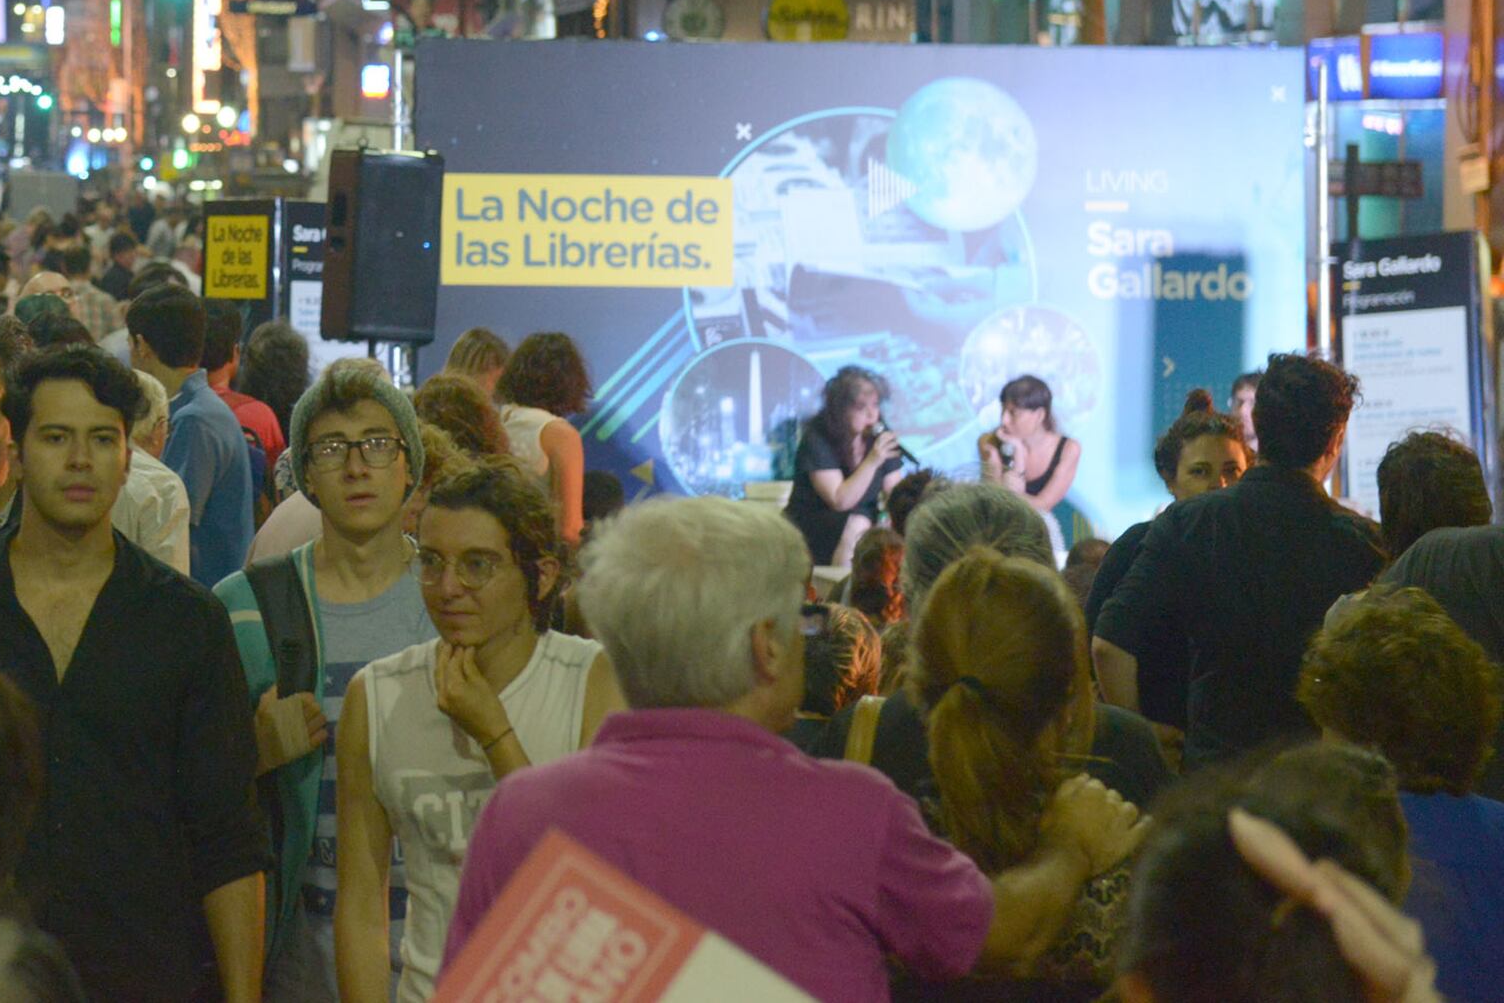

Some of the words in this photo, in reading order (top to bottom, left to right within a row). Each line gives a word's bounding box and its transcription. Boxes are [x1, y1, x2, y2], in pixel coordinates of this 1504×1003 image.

[1086, 168, 1169, 194] LIVING
[455, 187, 504, 222] La
[517, 188, 654, 224] Noche
[666, 189, 720, 225] de
[227, 224, 263, 243] Noche
[292, 224, 321, 243] Sara
[1087, 219, 1175, 258] Sara
[455, 231, 510, 267] las
[522, 231, 711, 270] Librerías.
[1342, 260, 1377, 280] Sara
[1377, 253, 1442, 277] Gallardo
[1087, 261, 1254, 301] Gallardo
